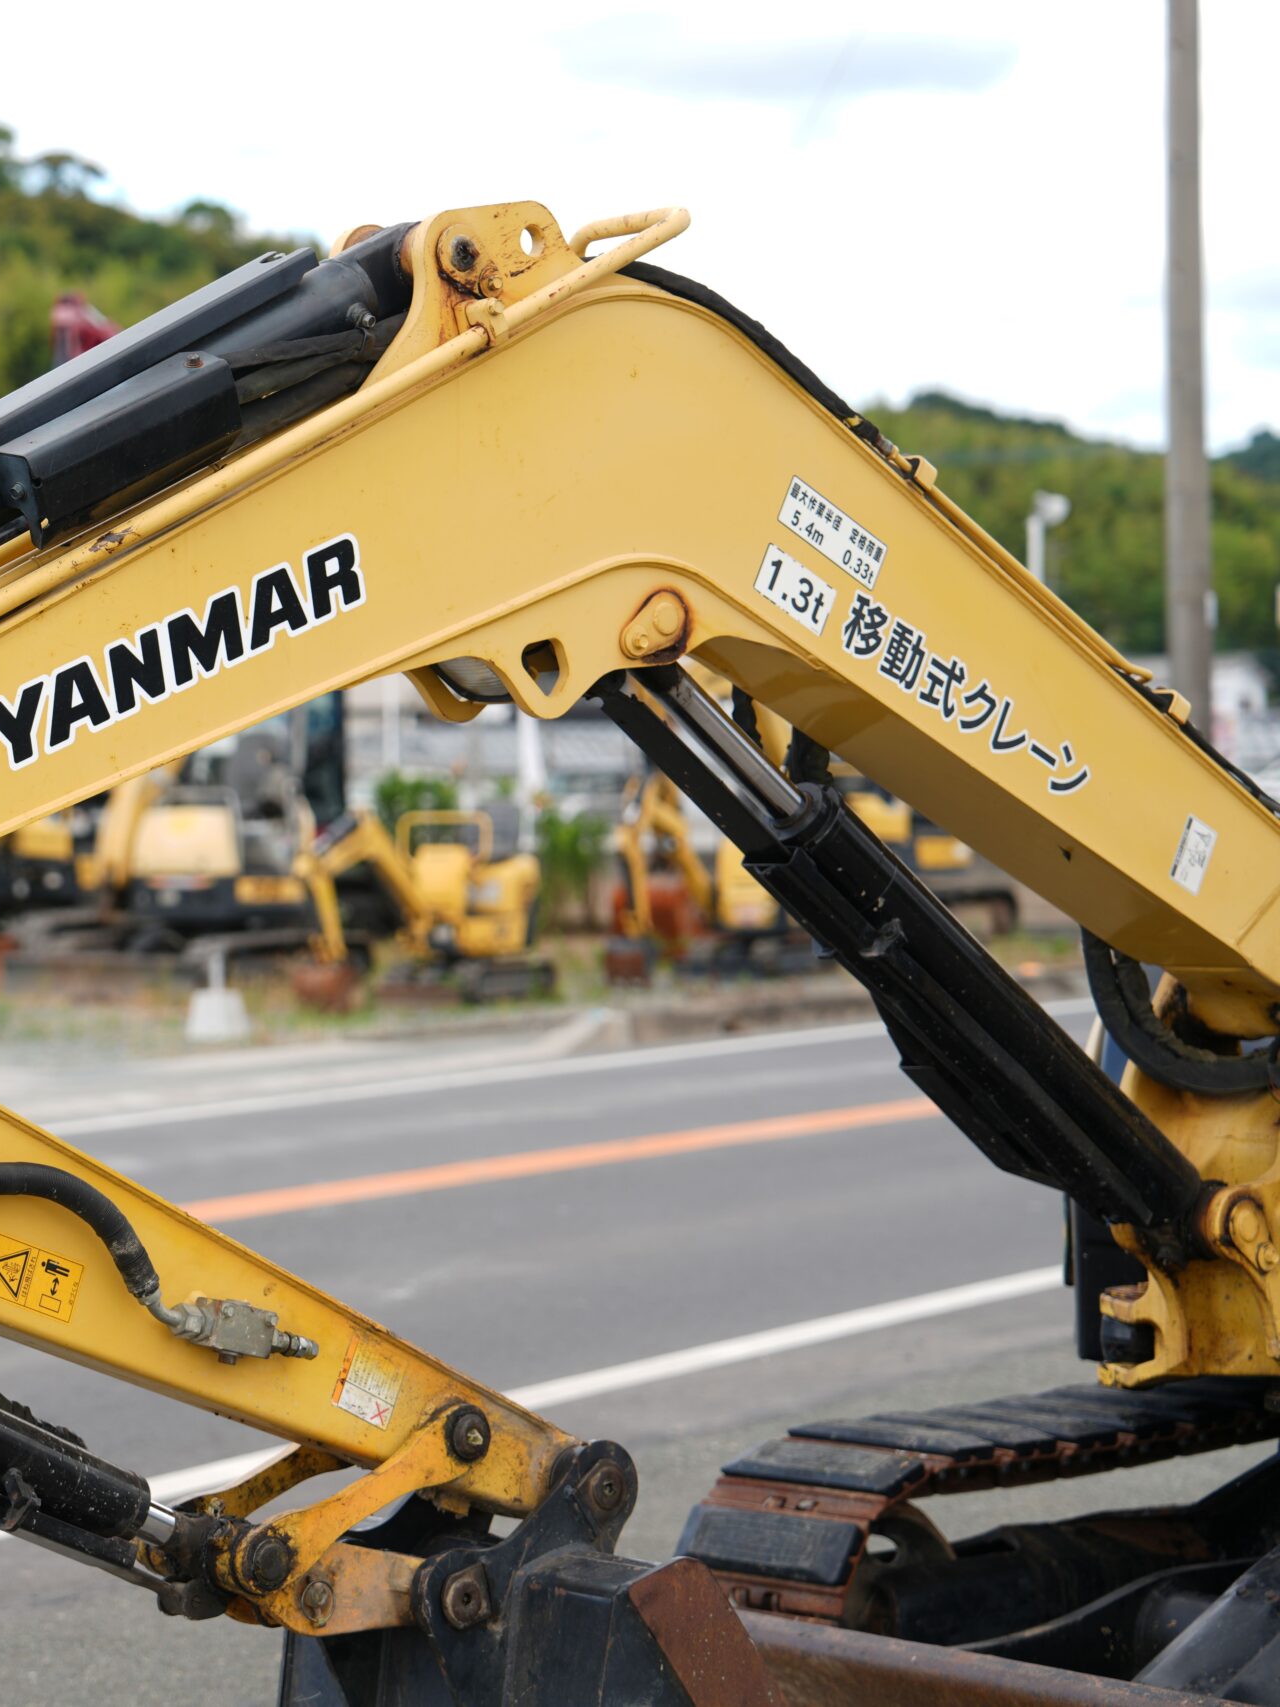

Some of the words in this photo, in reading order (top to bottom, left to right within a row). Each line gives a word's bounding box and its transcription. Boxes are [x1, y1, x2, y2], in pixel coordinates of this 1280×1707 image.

[790, 482, 843, 531] 最大作業半径
[849, 528, 883, 563] 定格荷重
[791, 510, 824, 546] 5.4m
[842, 549, 874, 584] 0.33t
[767, 559, 826, 624] 1.3t
[844, 594, 1088, 792] 移動式クレーン
